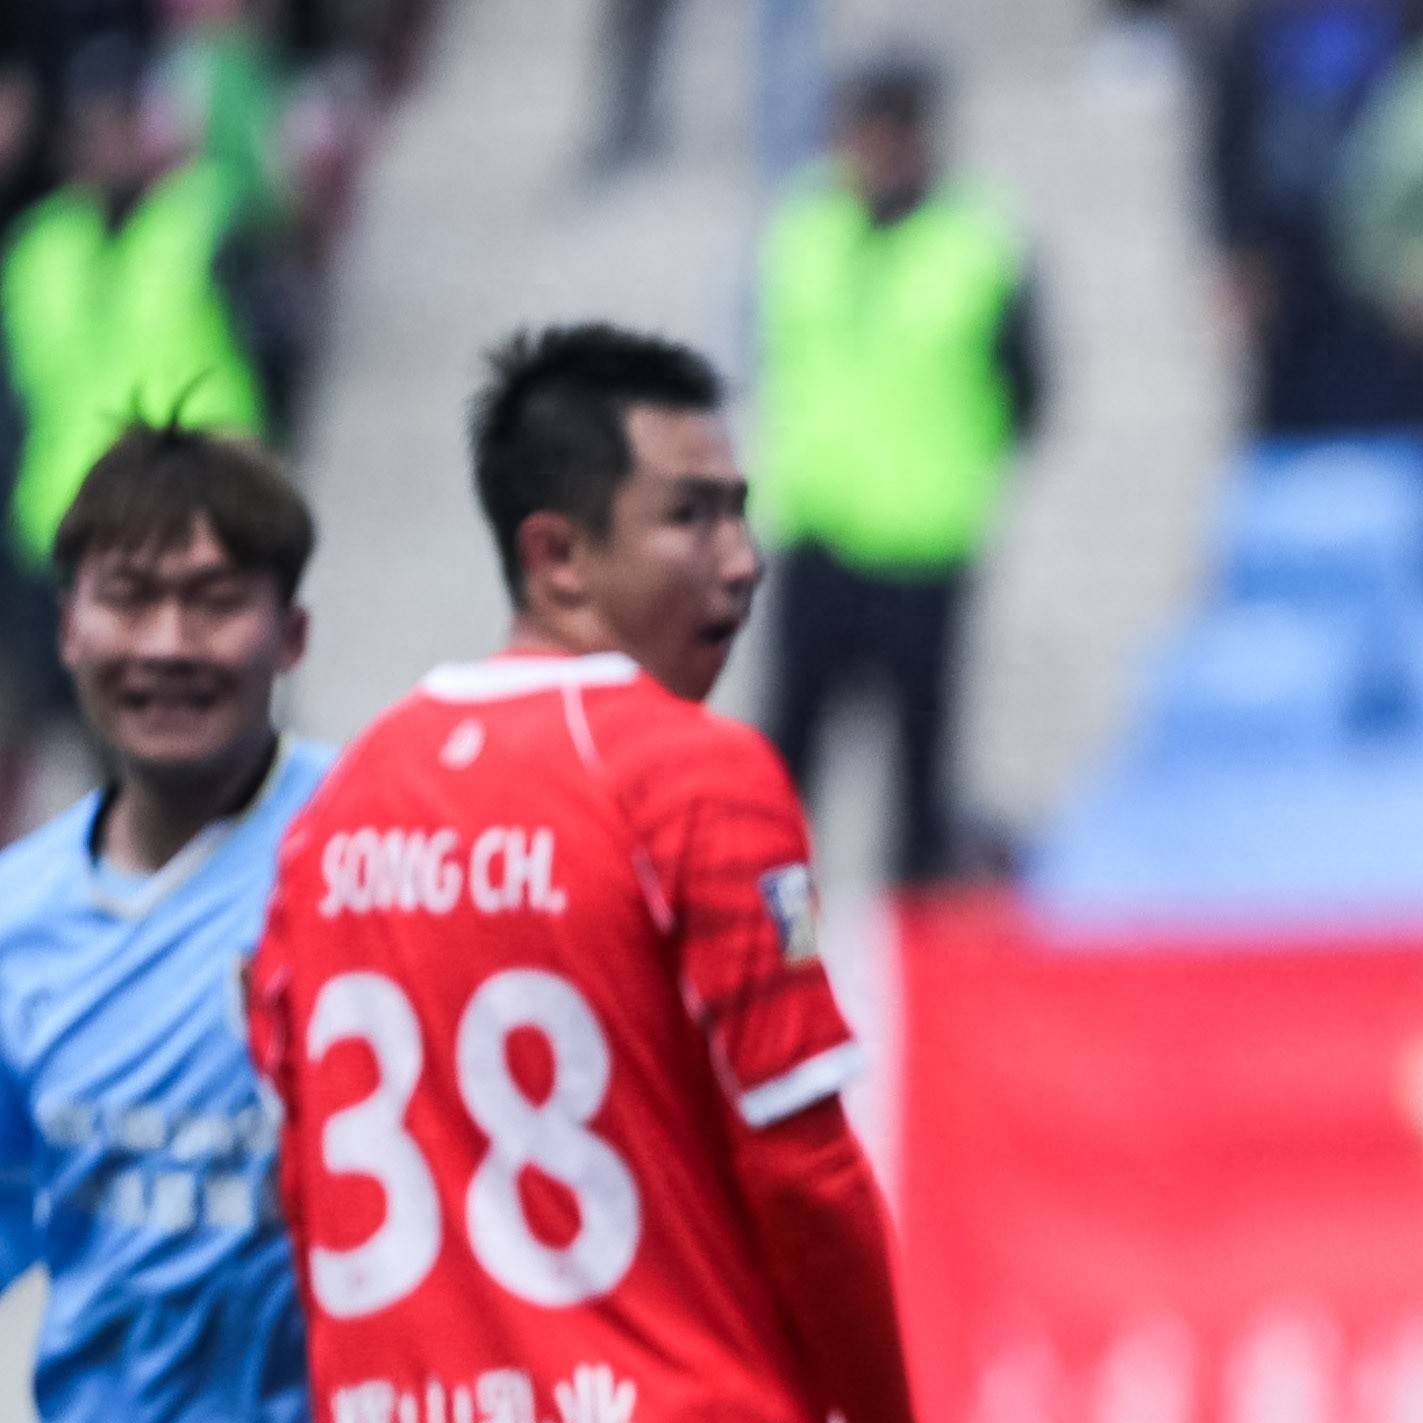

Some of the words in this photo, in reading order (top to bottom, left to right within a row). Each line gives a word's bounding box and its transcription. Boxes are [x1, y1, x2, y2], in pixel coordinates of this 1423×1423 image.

[320, 828, 462, 915] SONG
[470, 828, 565, 912] CH.
[307, 969, 640, 1319] 38
